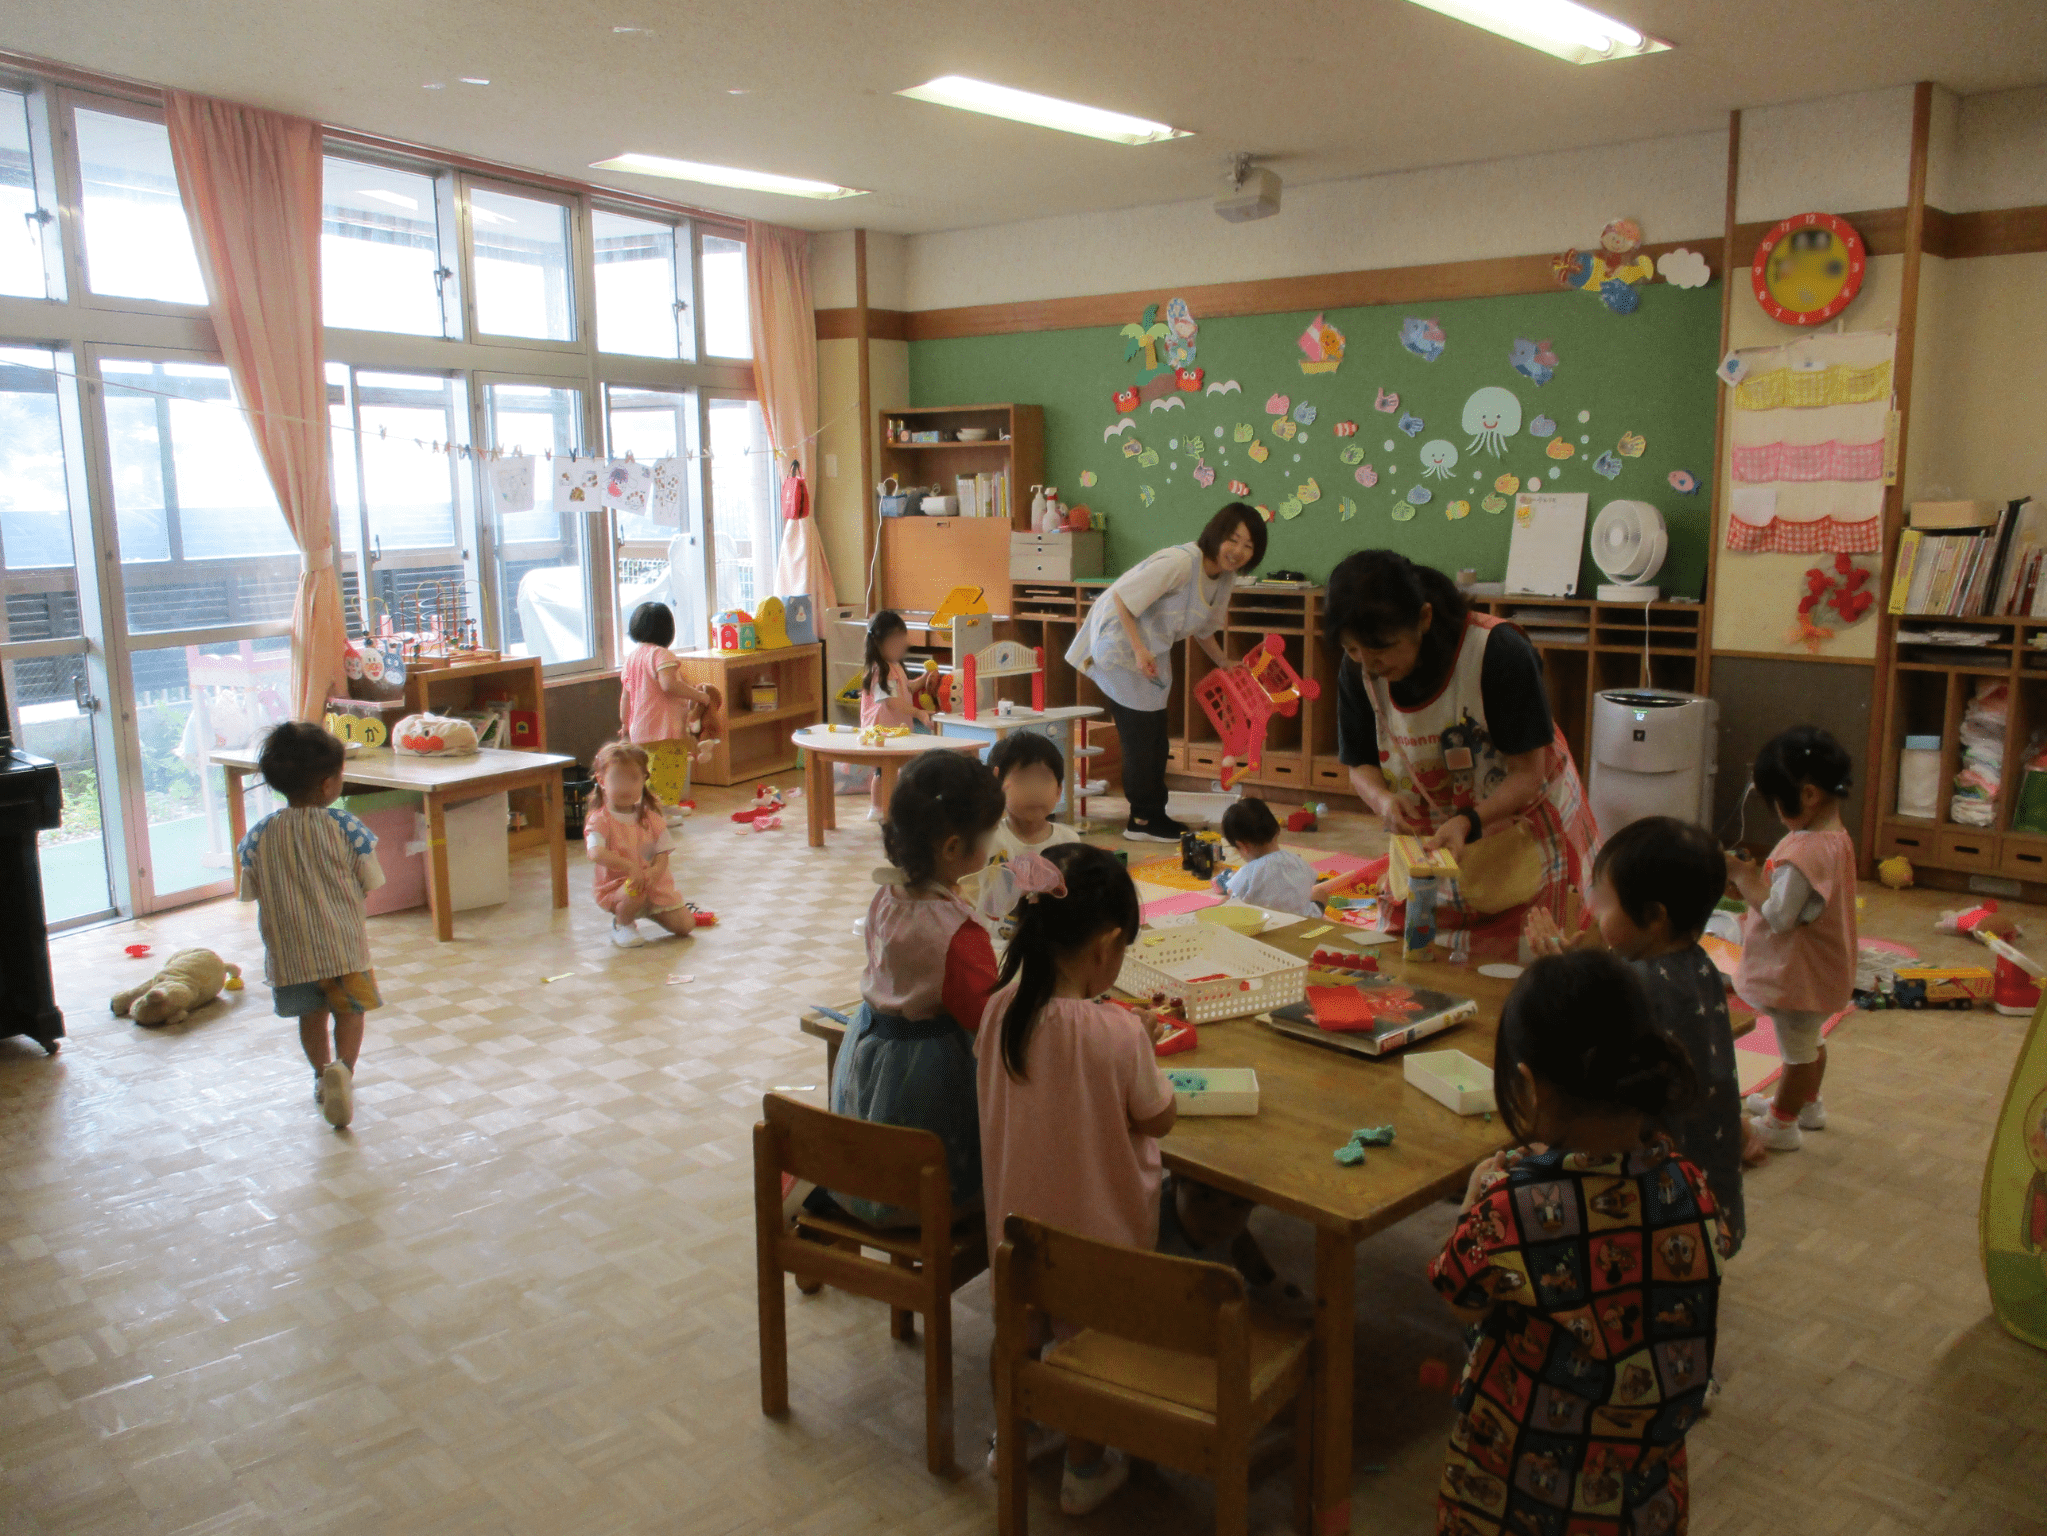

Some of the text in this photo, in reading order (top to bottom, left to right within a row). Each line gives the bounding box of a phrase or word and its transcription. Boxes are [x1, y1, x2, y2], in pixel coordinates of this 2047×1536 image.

[1805, 213, 1816, 225] 12
[1832, 220, 1836, 229] 1
[1781, 221, 1790, 232] 11
[1762, 241, 1773, 251] 10
[1847, 237, 1855, 248] 2
[1755, 266, 1762, 275] 9
[1852, 261, 1860, 273] 3
[1759, 290, 1766, 300] 8
[1775, 307, 1782, 317] 7
[1798, 313, 1806, 324] 6
[365, 727, 379, 742] か
